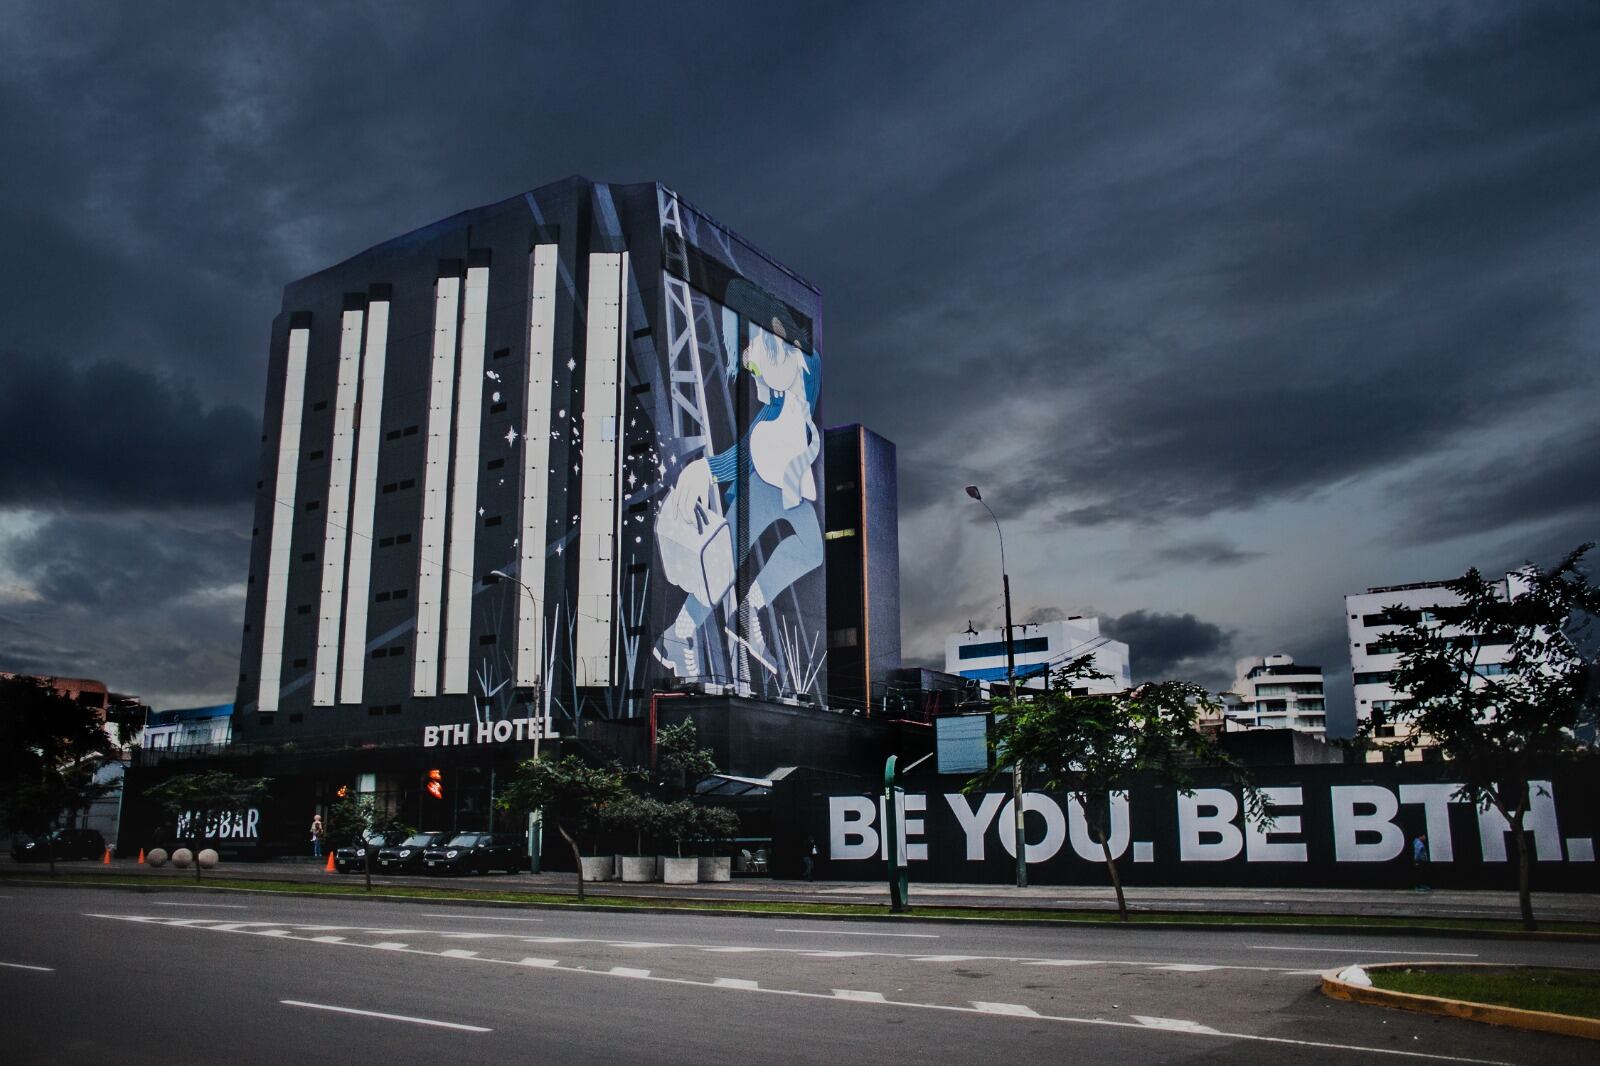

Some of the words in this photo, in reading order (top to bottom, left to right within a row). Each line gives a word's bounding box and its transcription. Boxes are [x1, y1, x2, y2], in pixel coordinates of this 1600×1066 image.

[424, 723, 470, 747] BTH
[477, 716, 560, 743] HOTEL
[176, 808, 259, 838] MDBAR
[829, 794, 928, 861] BE
[943, 789, 1154, 863] YOU.
[1176, 786, 1308, 862] BE
[1331, 780, 1596, 863] BTH.
